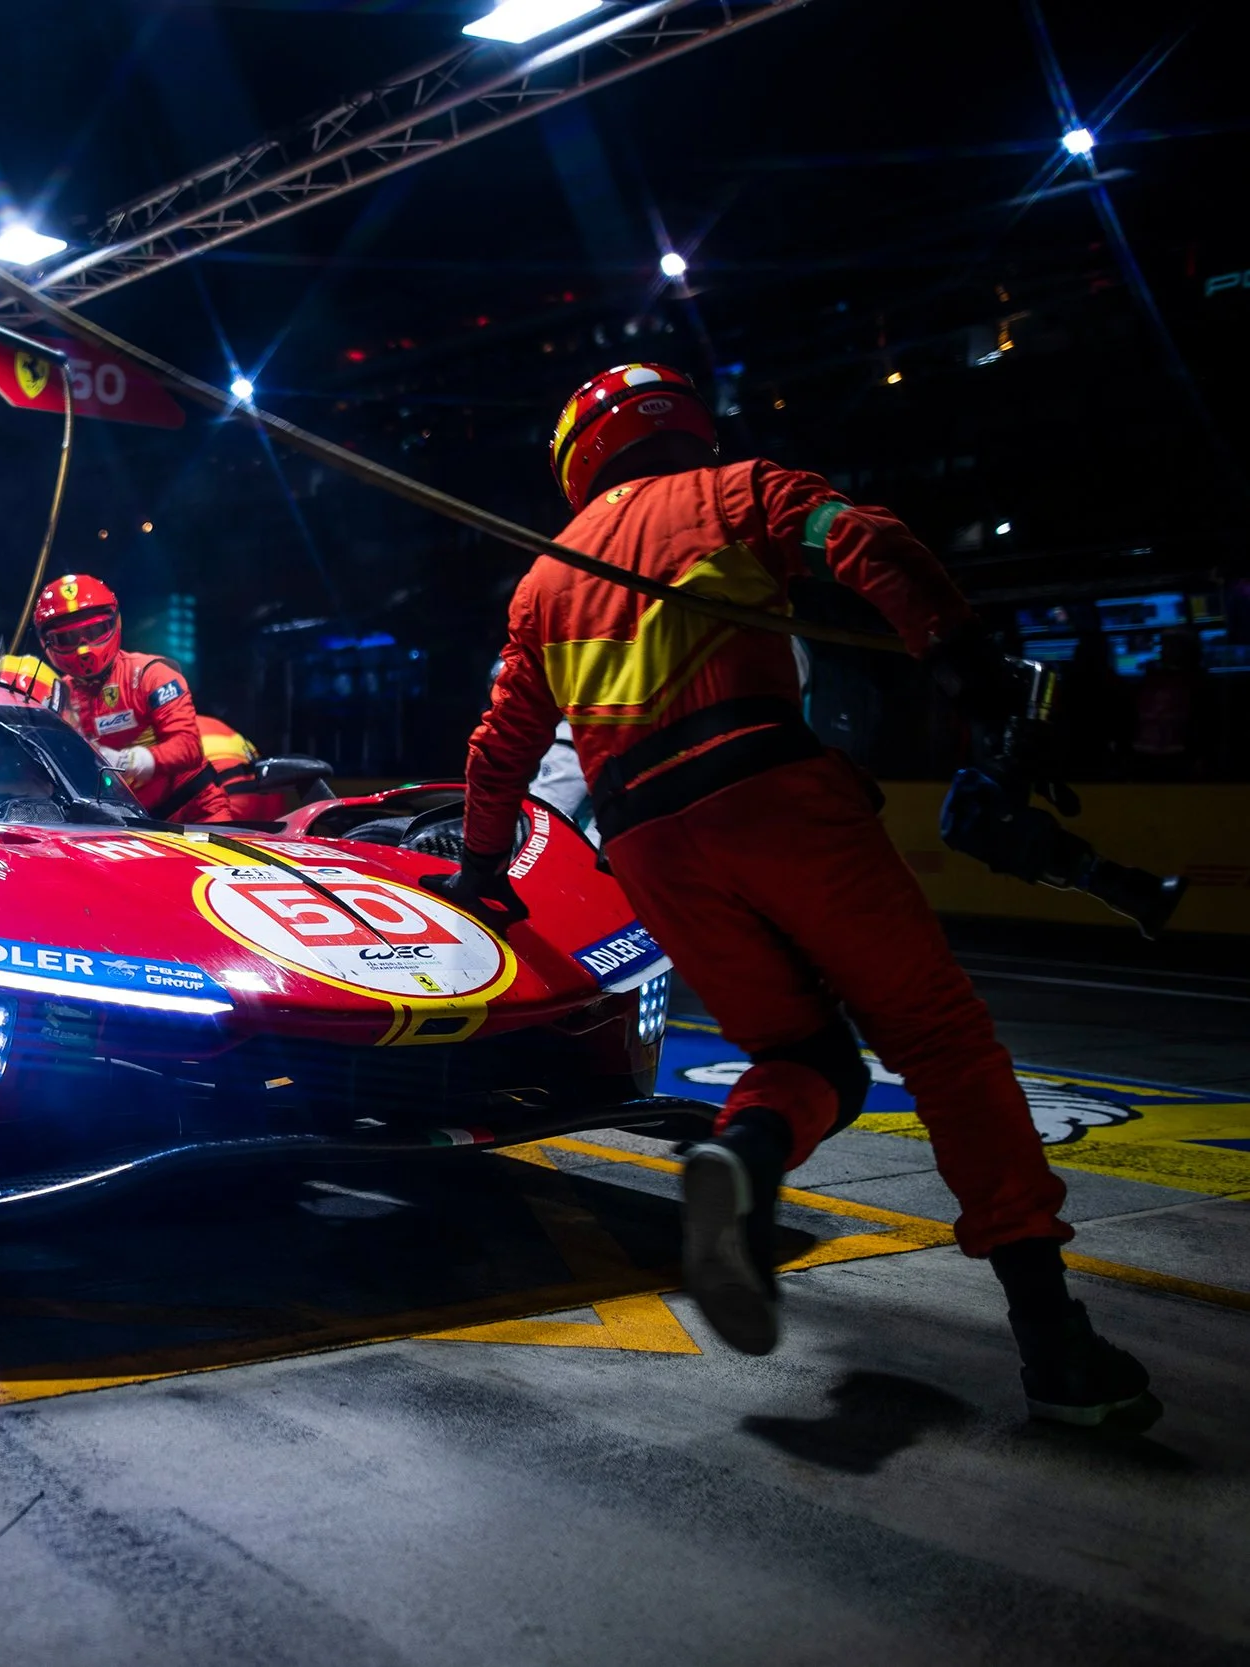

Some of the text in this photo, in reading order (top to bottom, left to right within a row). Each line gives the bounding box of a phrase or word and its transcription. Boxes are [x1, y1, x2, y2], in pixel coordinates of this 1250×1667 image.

[69, 359, 126, 405] 50
[99, 712, 131, 728] WEC
[507, 807, 550, 879] RICHARD MILLE
[248, 889, 429, 936] 50
[359, 945, 434, 960] WEC
[580, 938, 647, 976] ADLER
[144, 964, 203, 980] PELZER
[145, 975, 204, 991] GROUP
